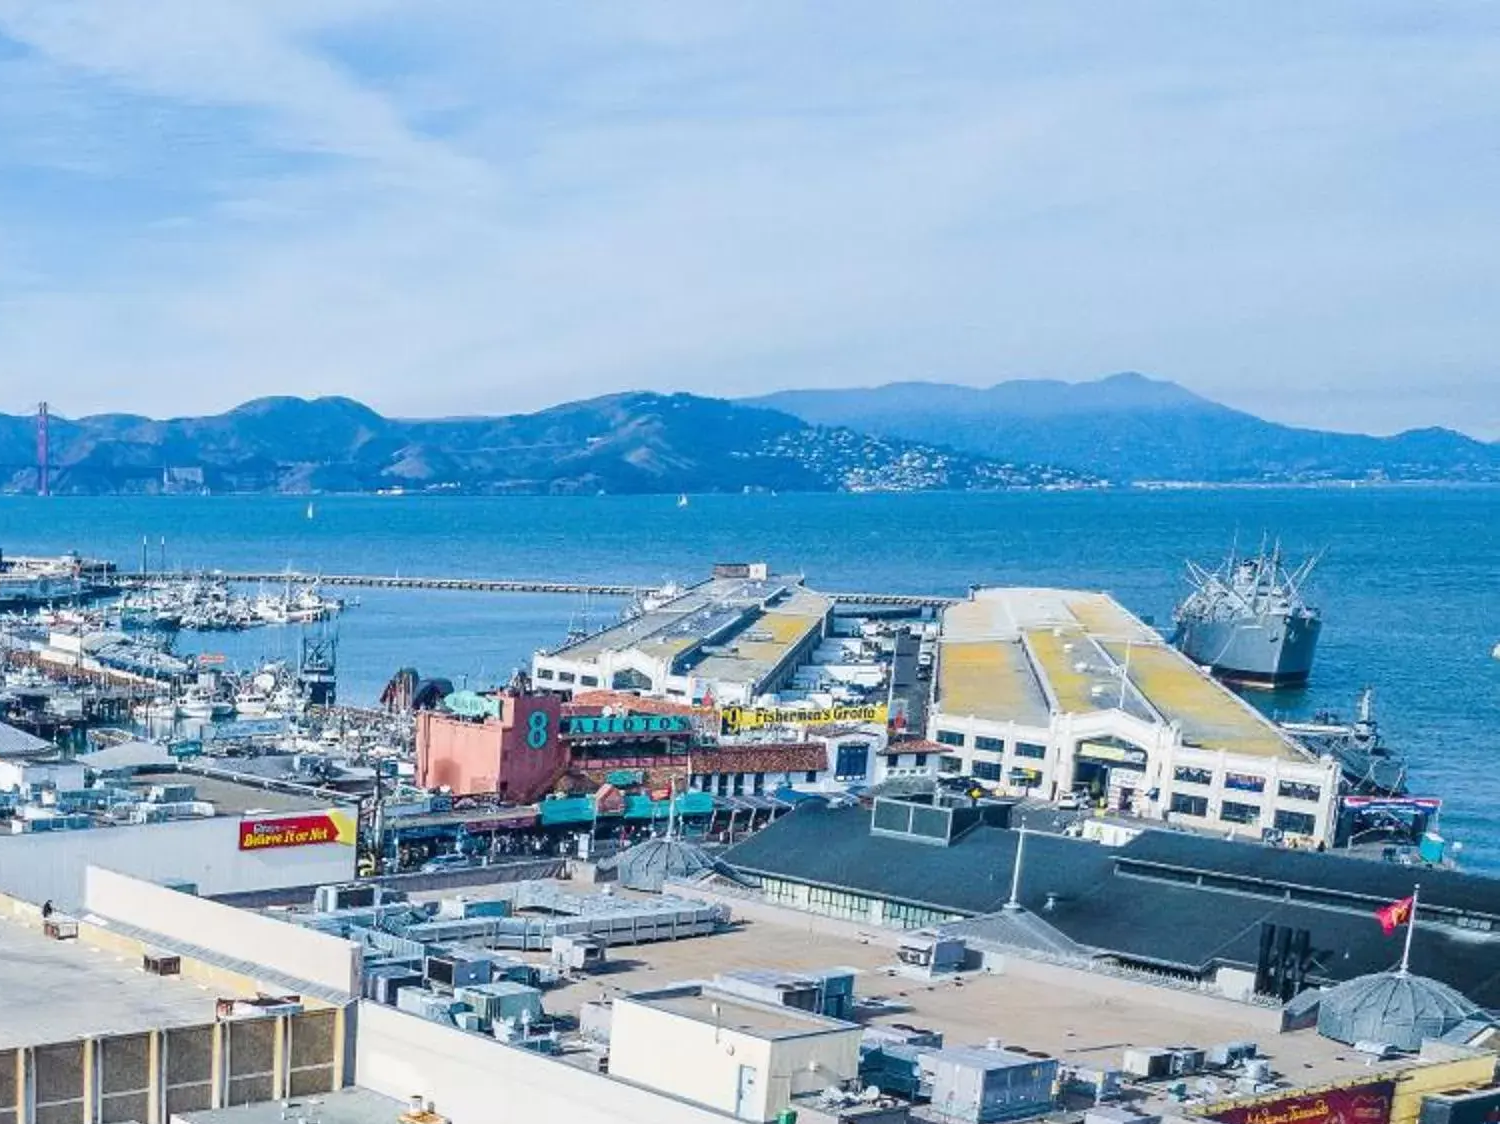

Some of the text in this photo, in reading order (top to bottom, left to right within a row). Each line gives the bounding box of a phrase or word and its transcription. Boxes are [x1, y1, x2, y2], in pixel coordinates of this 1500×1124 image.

[834, 705, 875, 720] Grotto
[527, 711, 548, 748] 8
[570, 715, 688, 734] ALIOTO'S
